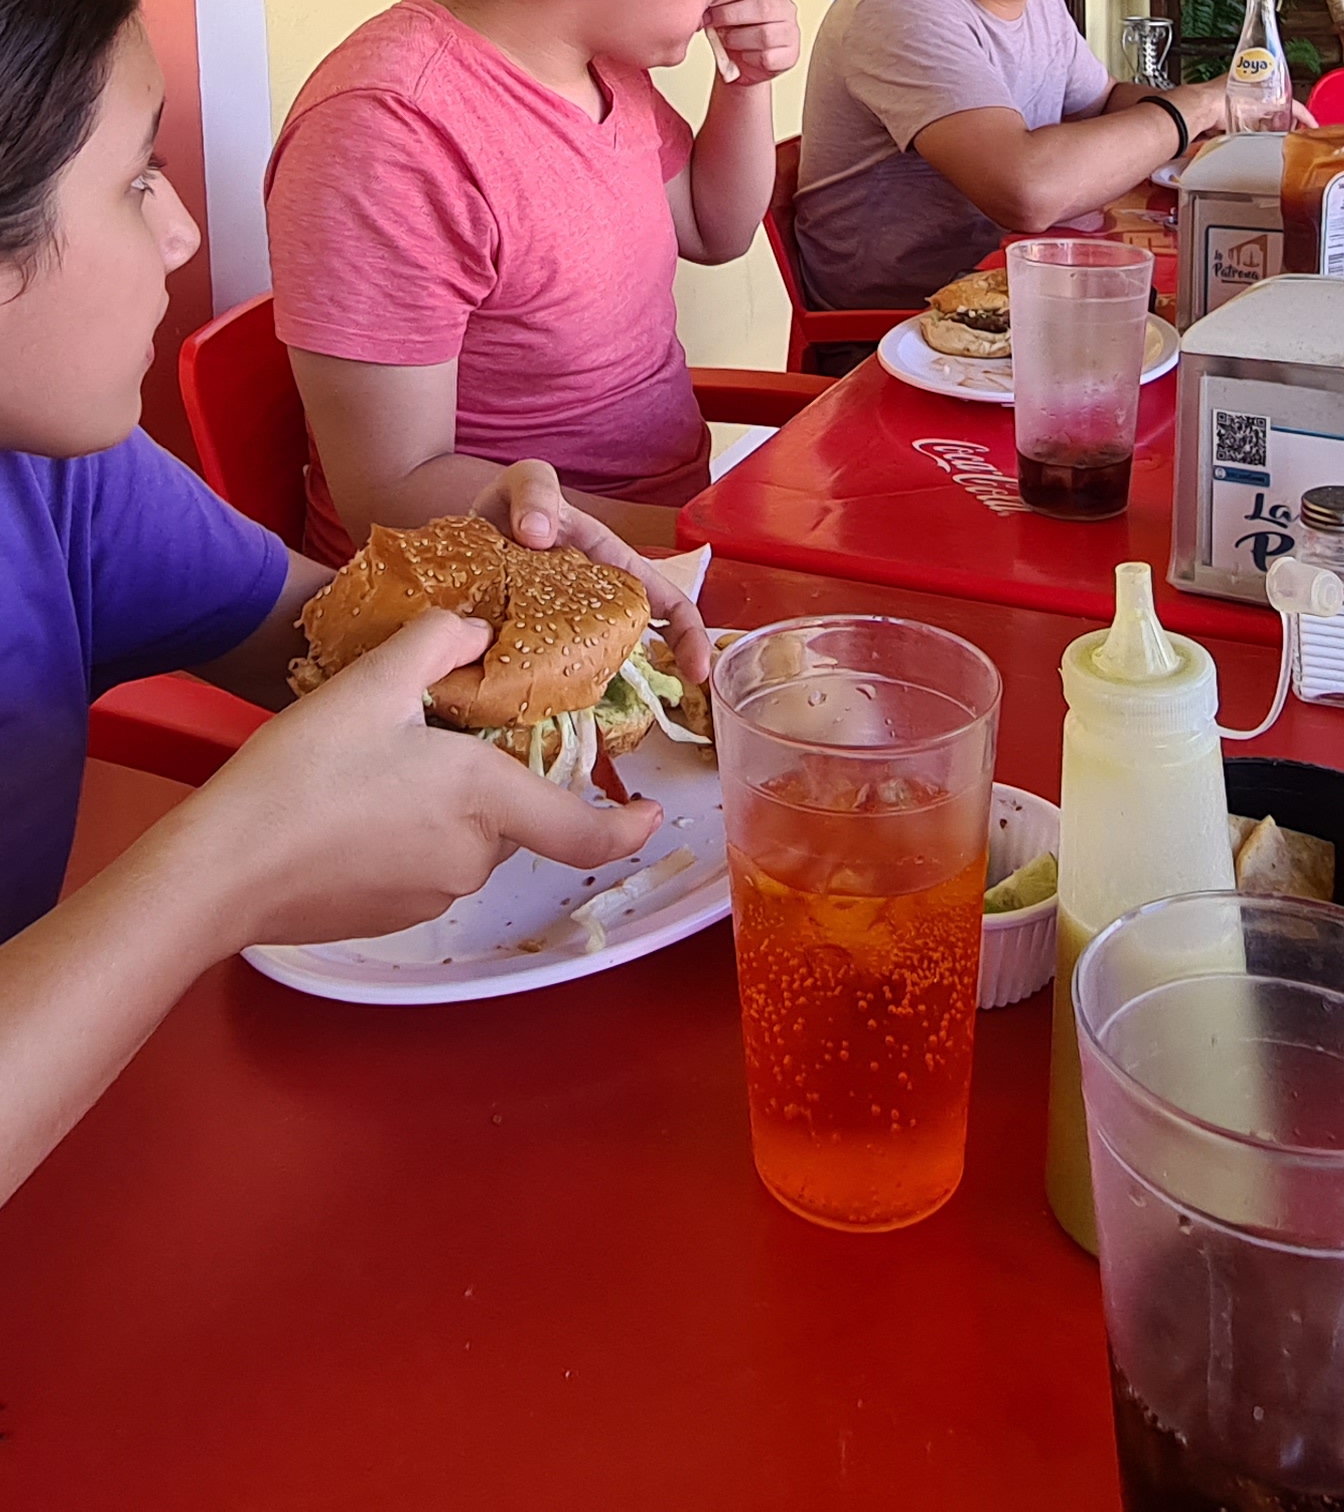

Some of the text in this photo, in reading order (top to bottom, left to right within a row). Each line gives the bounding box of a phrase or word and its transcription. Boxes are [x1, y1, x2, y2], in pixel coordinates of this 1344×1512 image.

[1236, 56, 1268, 74] Joya
[911, 438, 1033, 517] Coca-Cola
[1244, 492, 1301, 529] La
